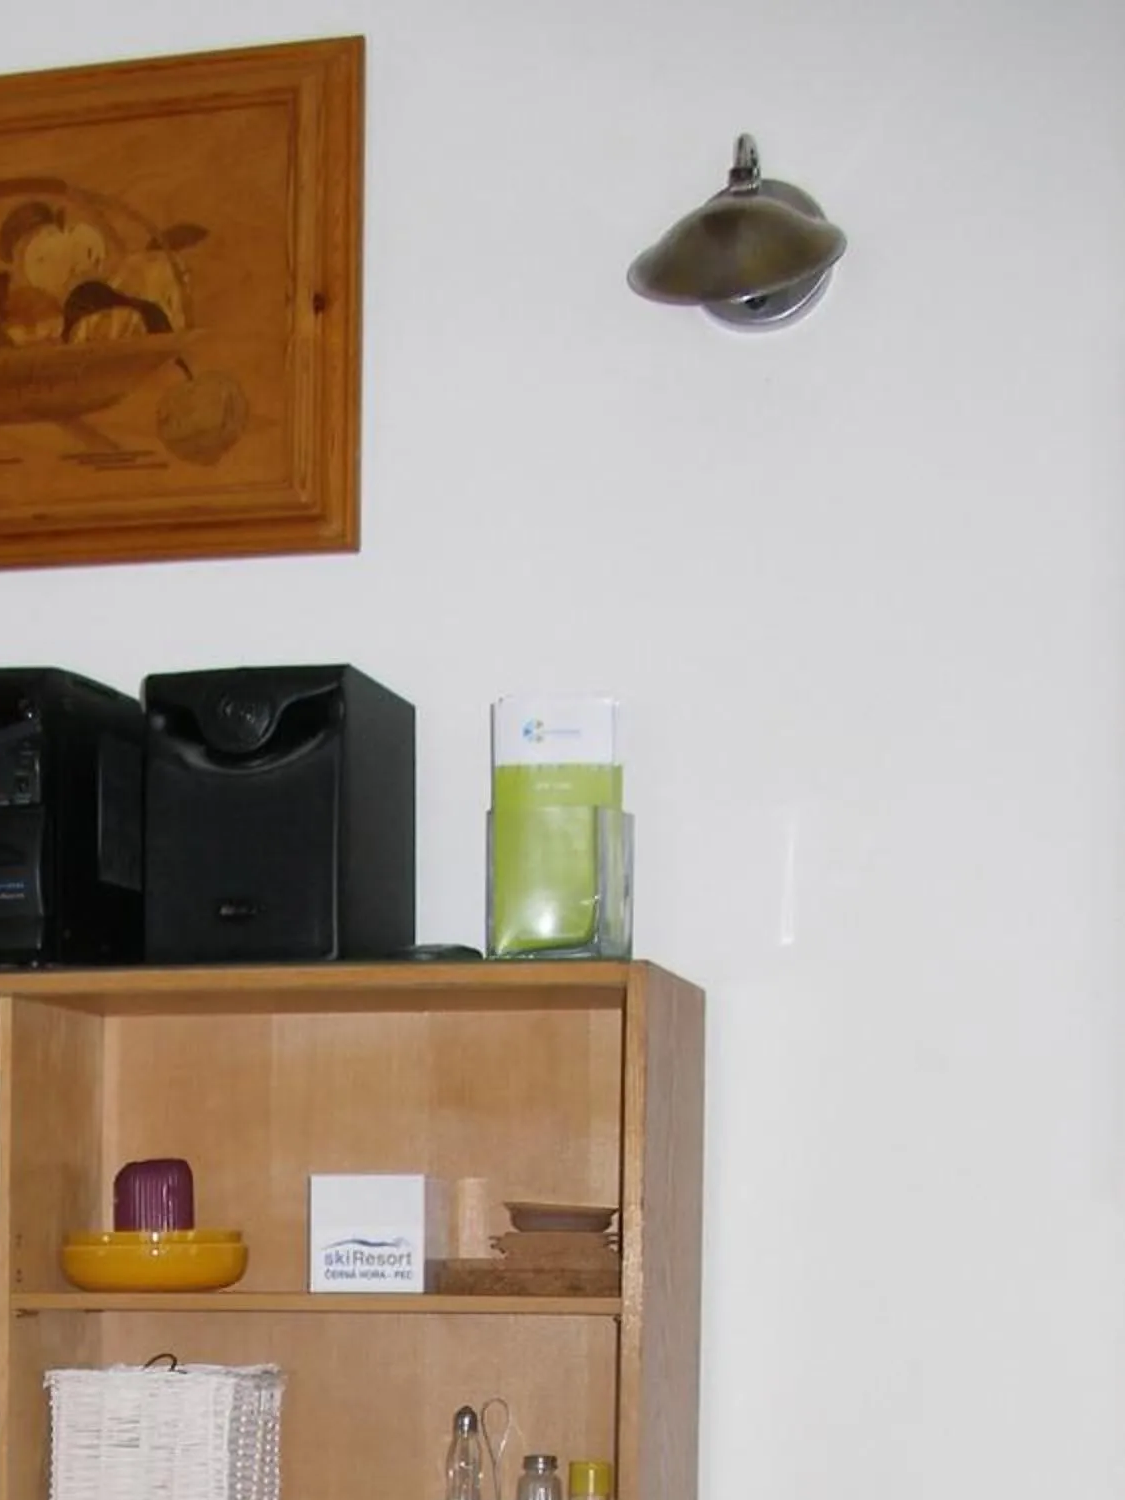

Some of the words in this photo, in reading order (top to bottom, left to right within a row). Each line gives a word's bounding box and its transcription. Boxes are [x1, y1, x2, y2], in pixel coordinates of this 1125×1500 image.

[324, 1251, 412, 1266] skiResort
[324, 1268, 357, 1280] ČERNÁ
[359, 1270, 386, 1280] HORA
[395, 1270, 413, 1280] PEC
